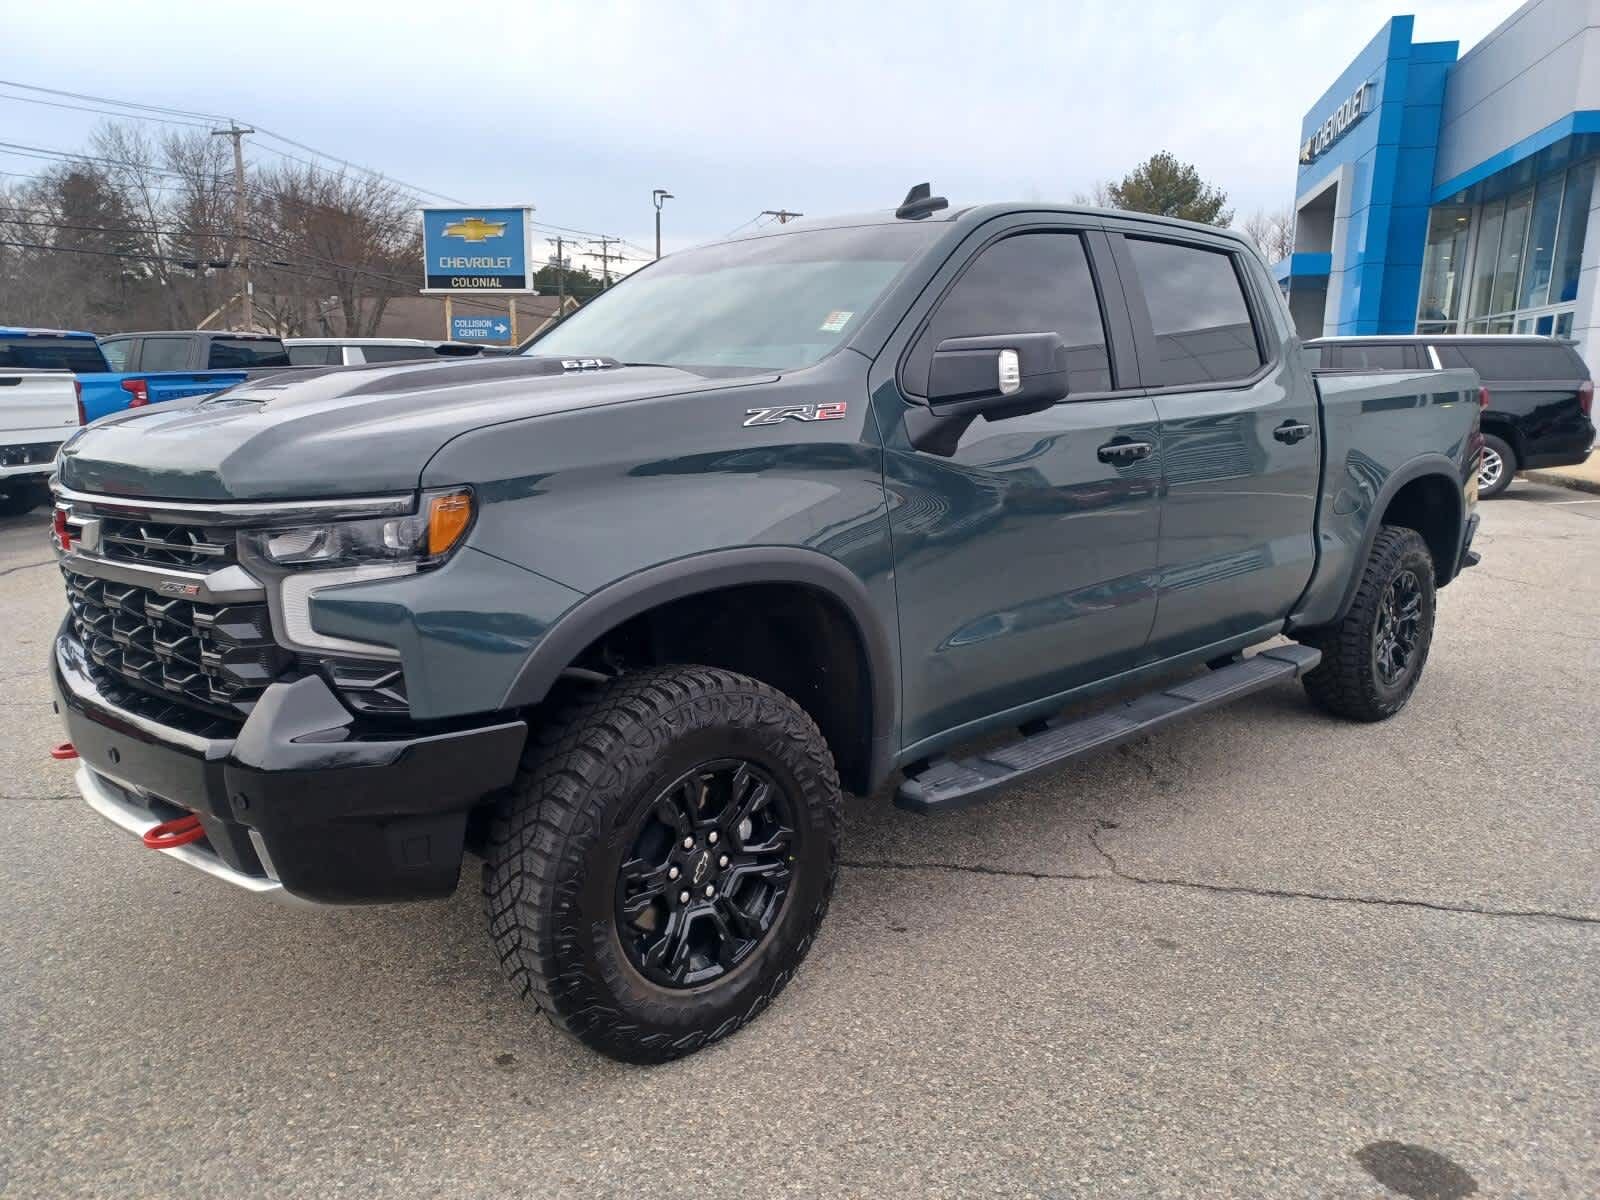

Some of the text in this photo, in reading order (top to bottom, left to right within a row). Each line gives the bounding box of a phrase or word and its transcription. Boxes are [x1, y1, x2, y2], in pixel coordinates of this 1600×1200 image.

[1311, 80, 1374, 155] CHEVROLET
[439, 257, 513, 269] CHEVROLET
[451, 277, 502, 288] COLONIAL
[454, 319, 492, 328] COLLISION
[459, 329, 488, 337] CENTER
[743, 401, 847, 426] ZR2
